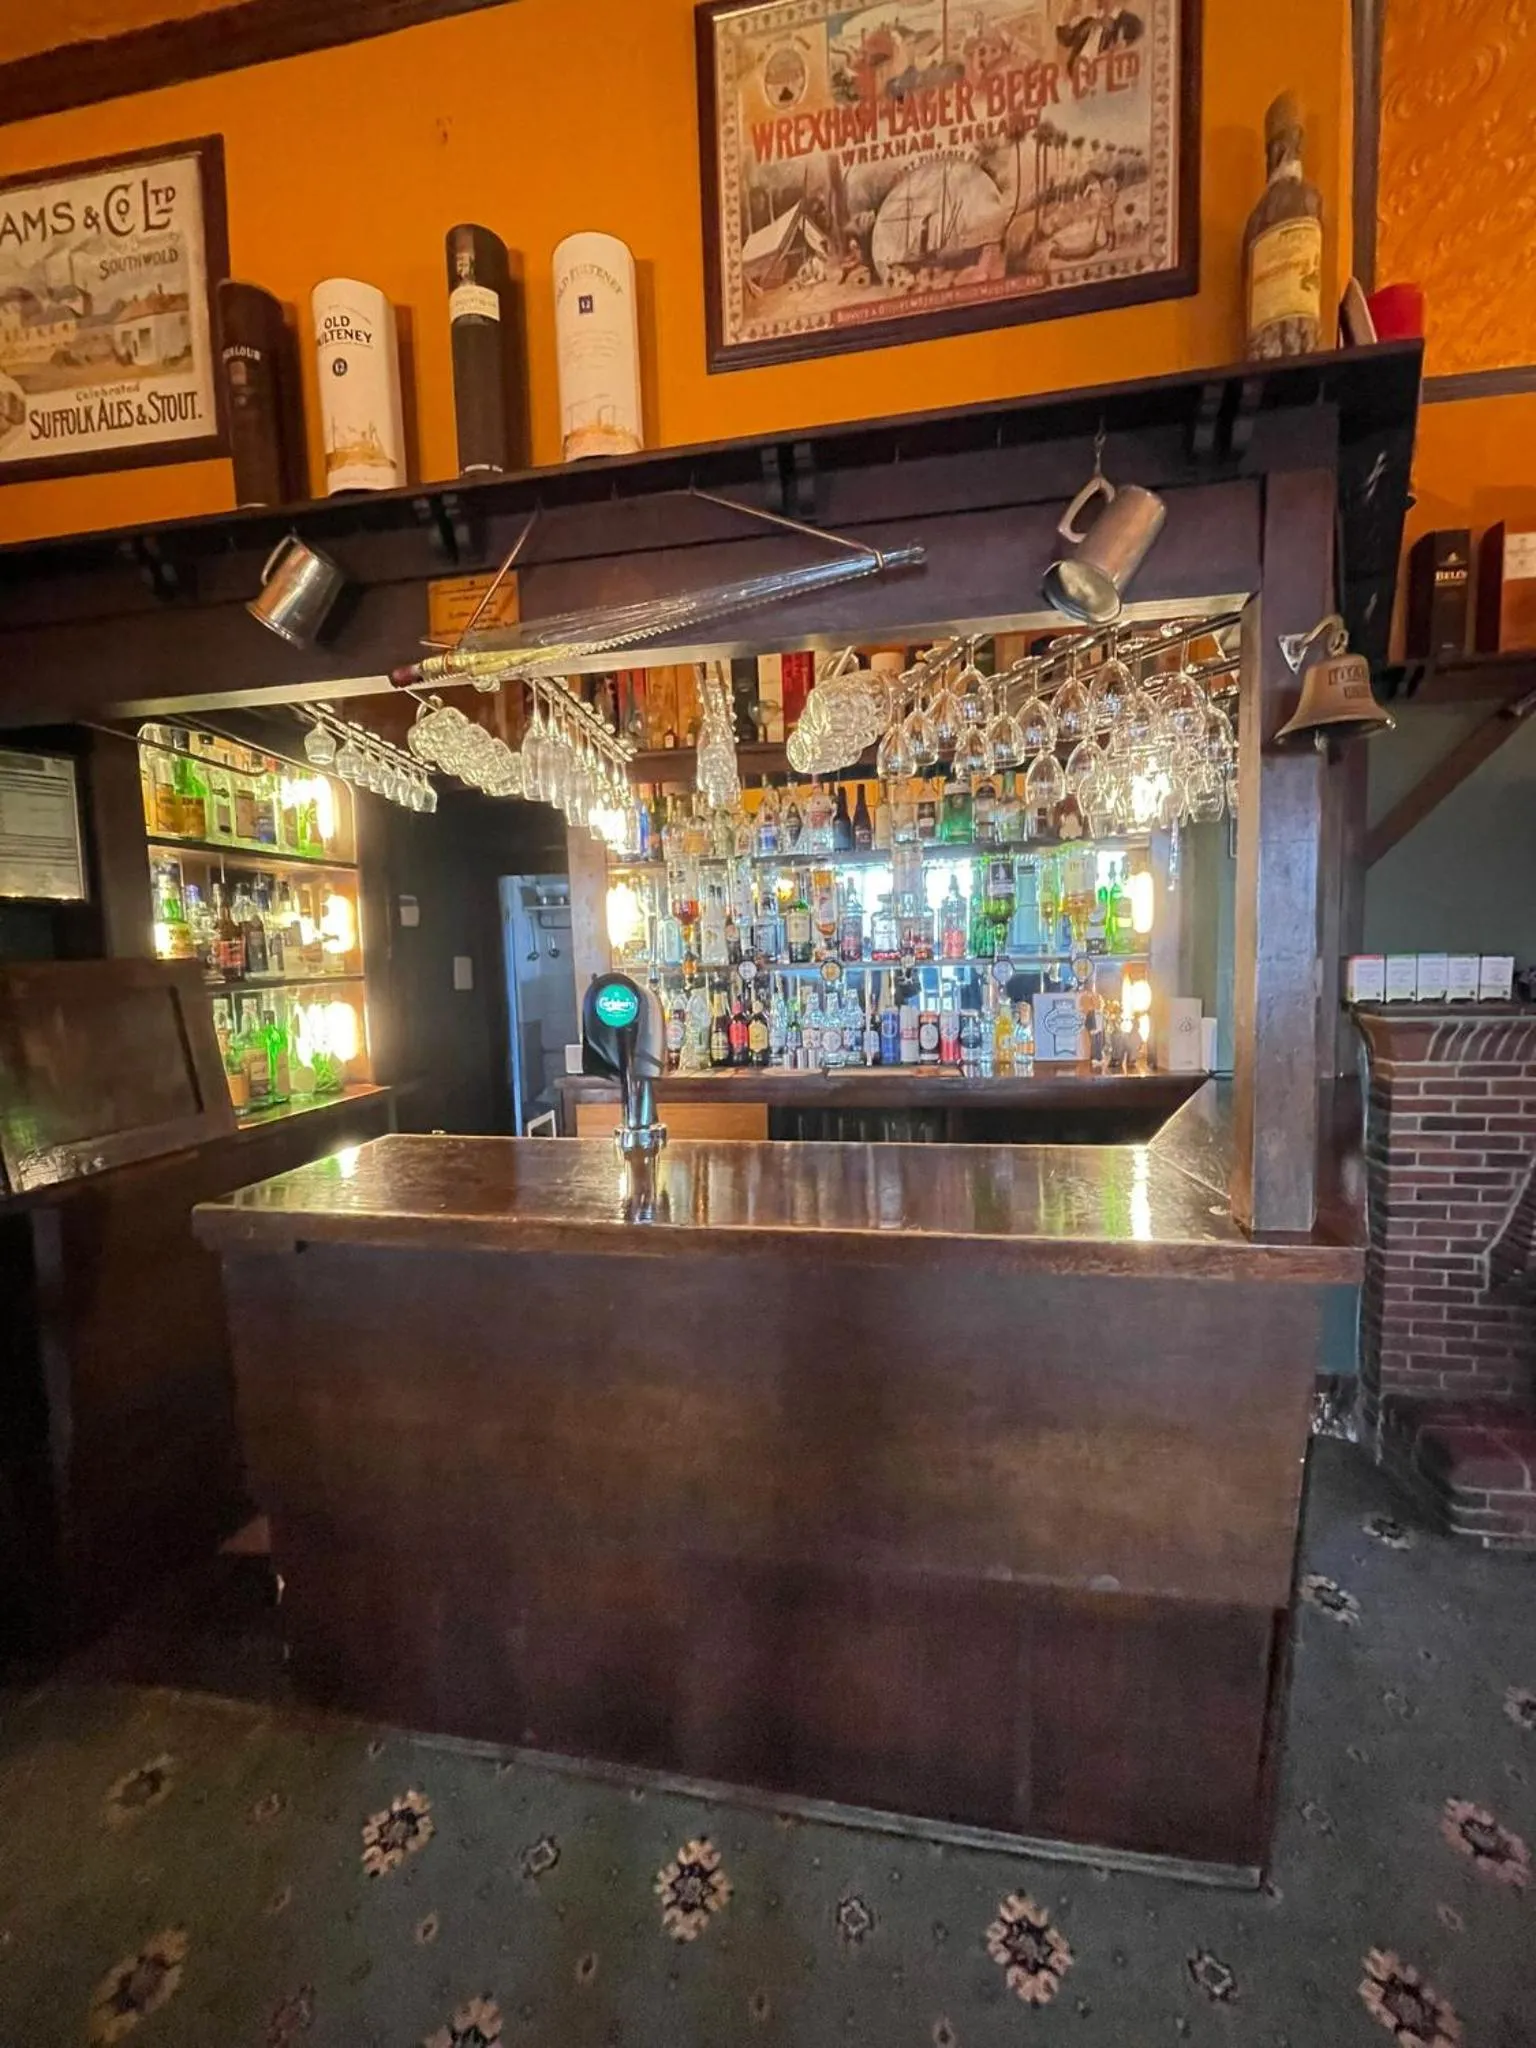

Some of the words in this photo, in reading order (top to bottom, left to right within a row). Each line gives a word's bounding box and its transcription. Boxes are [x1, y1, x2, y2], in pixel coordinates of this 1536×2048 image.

[752, 102, 878, 165] WREXHAM
[888, 78, 976, 137] LAGER
[987, 62, 1060, 117] BEER
[0, 202, 75, 246] AMS
[84, 205, 101, 234] &
[100, 248, 179, 281] SOUTHWOLD
[324, 315, 350, 329] OLD
[29, 405, 95, 441] SUFFOLK
[97, 398, 134, 432] ALES
[136, 404, 146, 427] &
